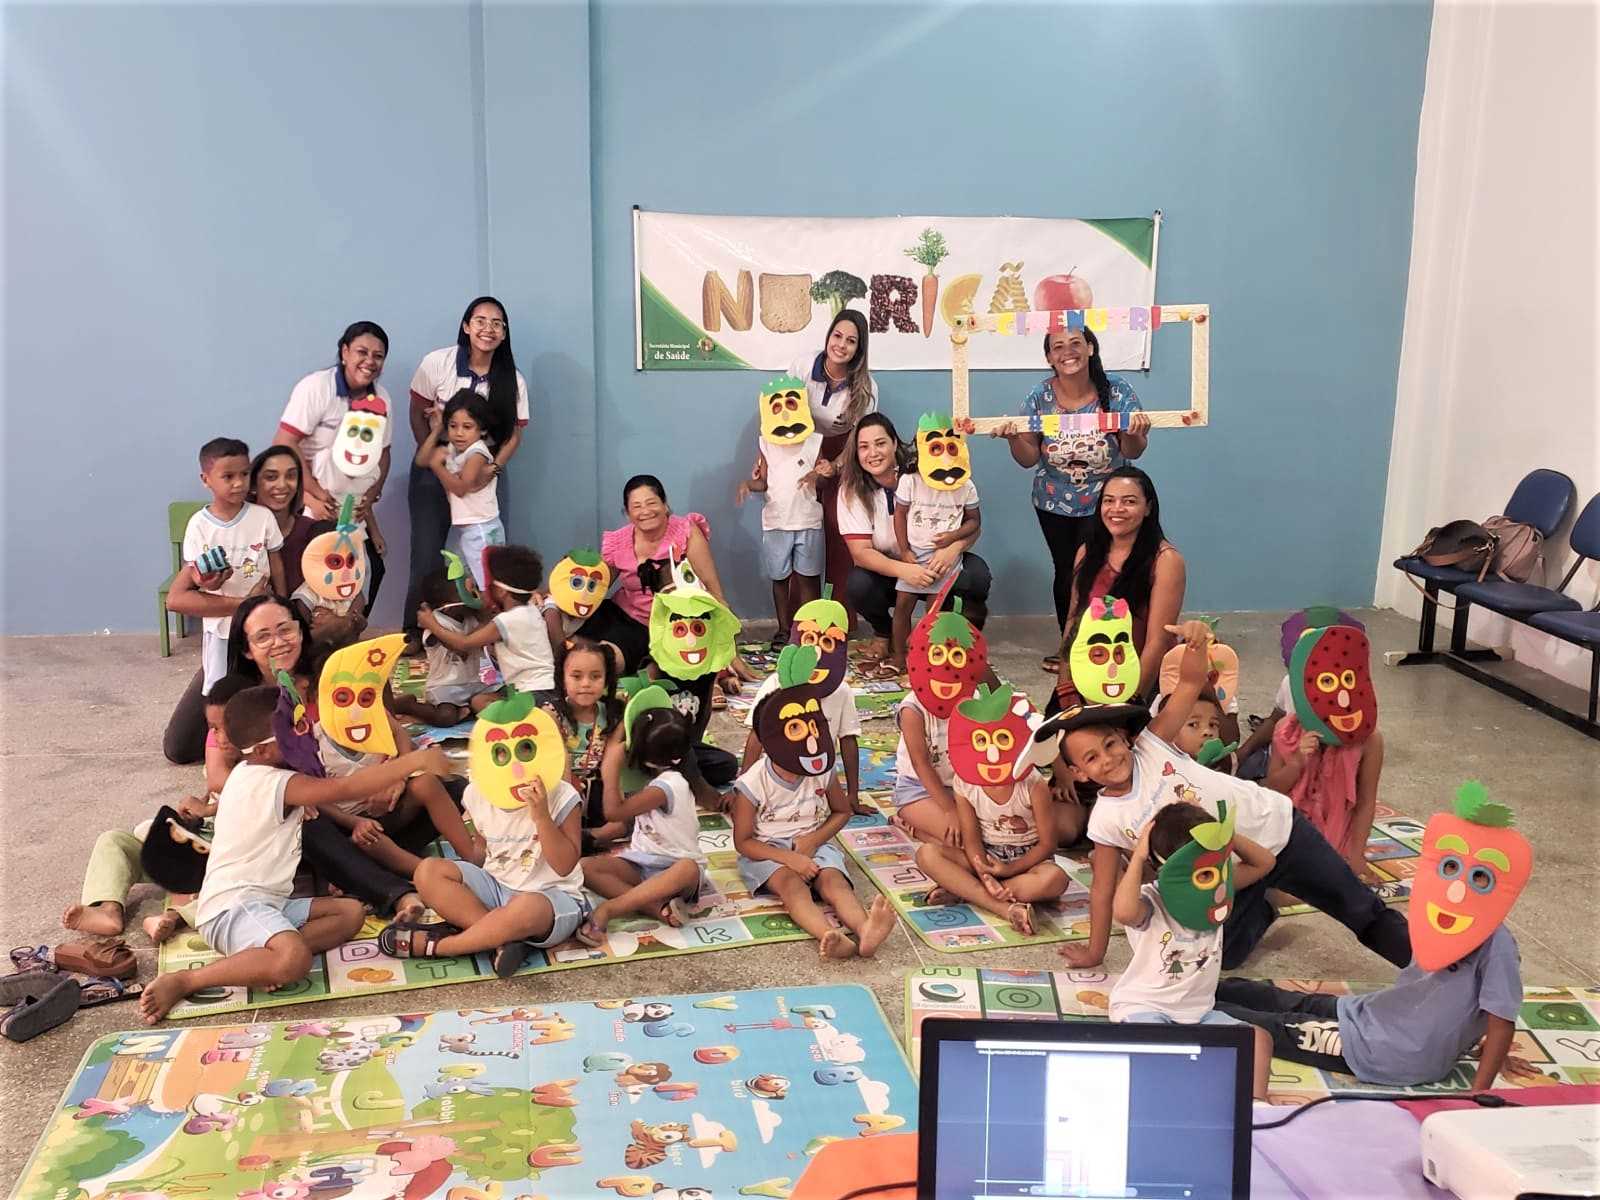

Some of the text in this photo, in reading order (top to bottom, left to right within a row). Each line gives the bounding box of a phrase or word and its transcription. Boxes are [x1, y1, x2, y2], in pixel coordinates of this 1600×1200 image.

[654, 350, 690, 360] de Saúde
[731, 1078, 748, 1099] bird
